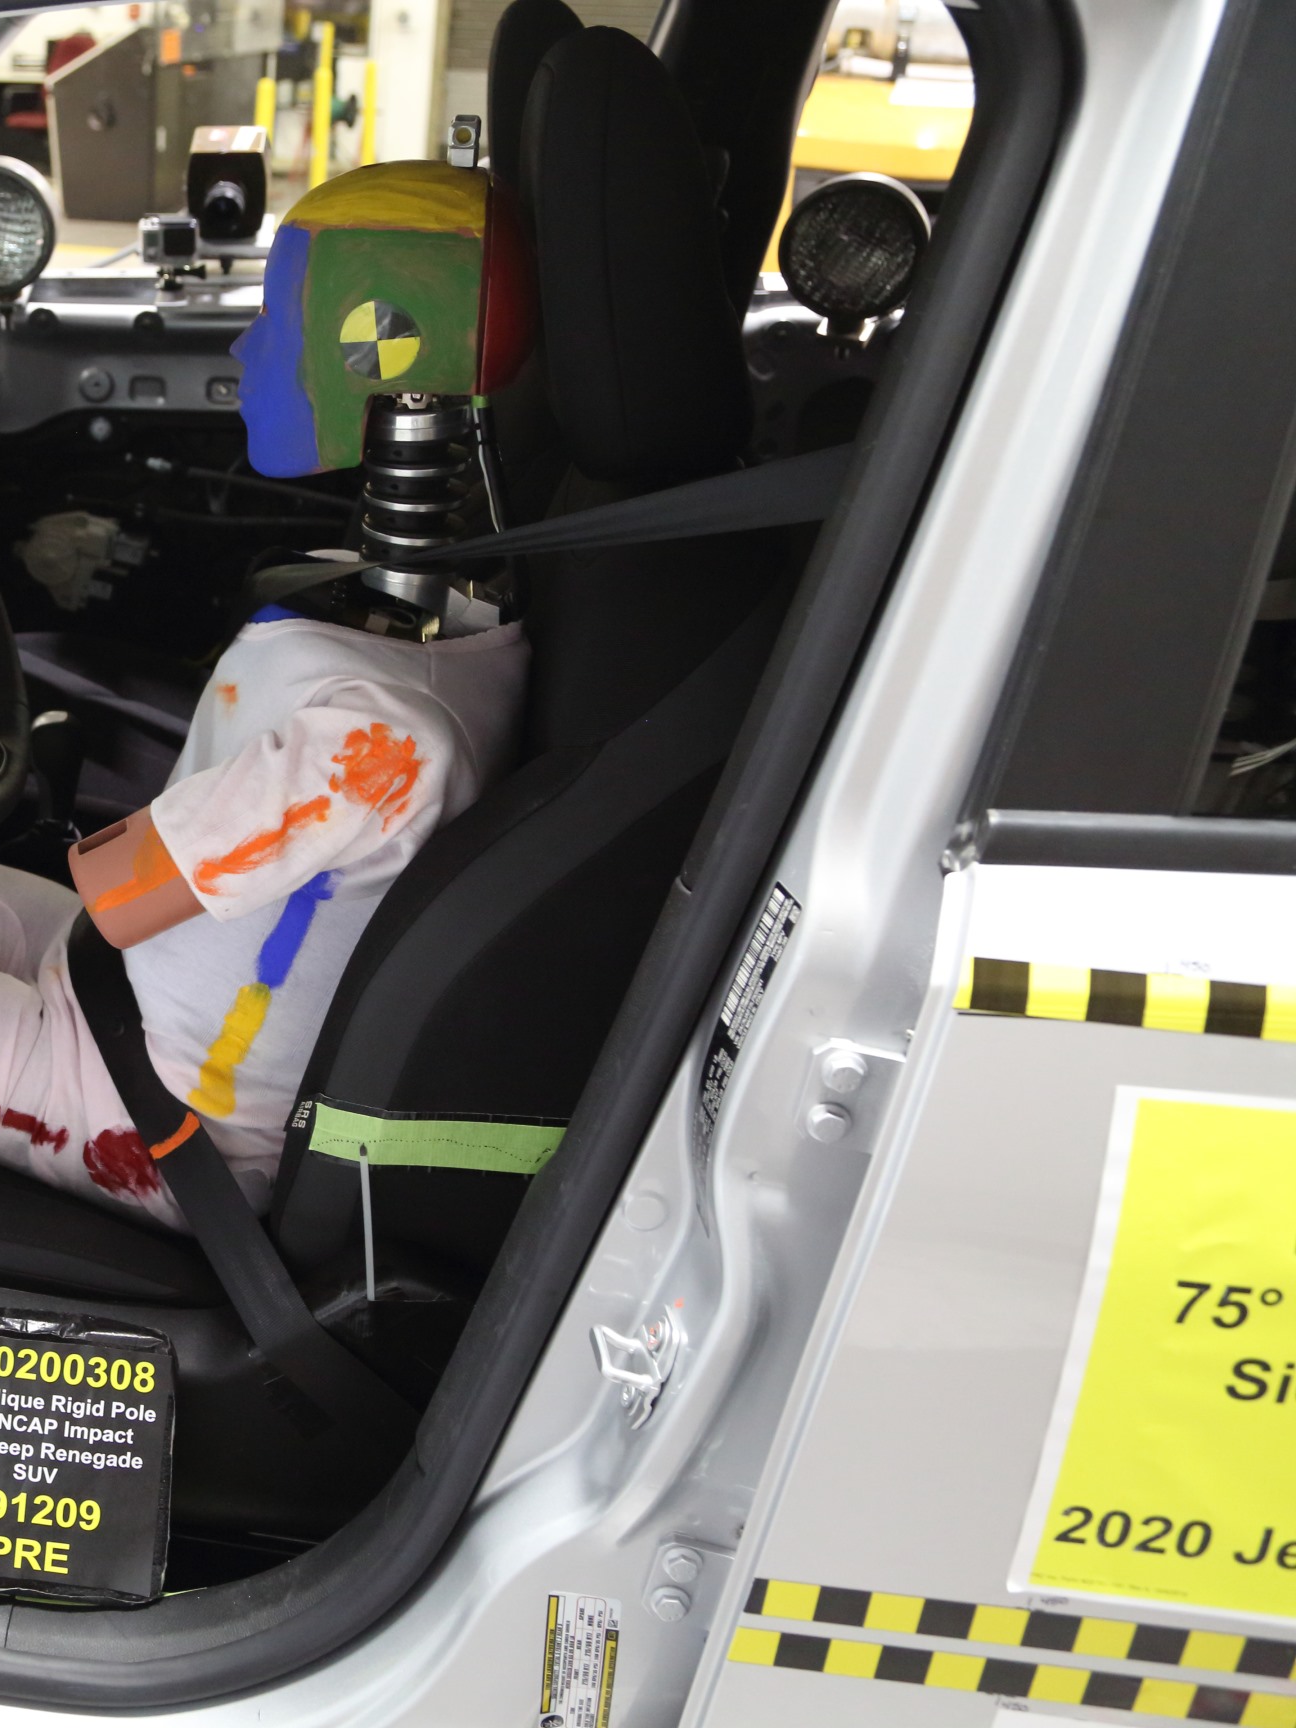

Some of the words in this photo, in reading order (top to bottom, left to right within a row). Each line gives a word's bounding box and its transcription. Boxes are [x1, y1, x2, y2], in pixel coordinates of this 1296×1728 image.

[298, 1101, 312, 1128] SRS
[1175, 1280, 1284, 1329] 75°
[1225, 1358, 1296, 1404] Si
[51, 1395, 104, 1419] Rigid
[111, 1402, 156, 1422] Pole
[64, 1419, 134, 1444] Impact
[40, 1443, 143, 1470] Renegade
[13, 1463, 58, 1484] SUV
[1054, 1506, 1213, 1558] 2020
